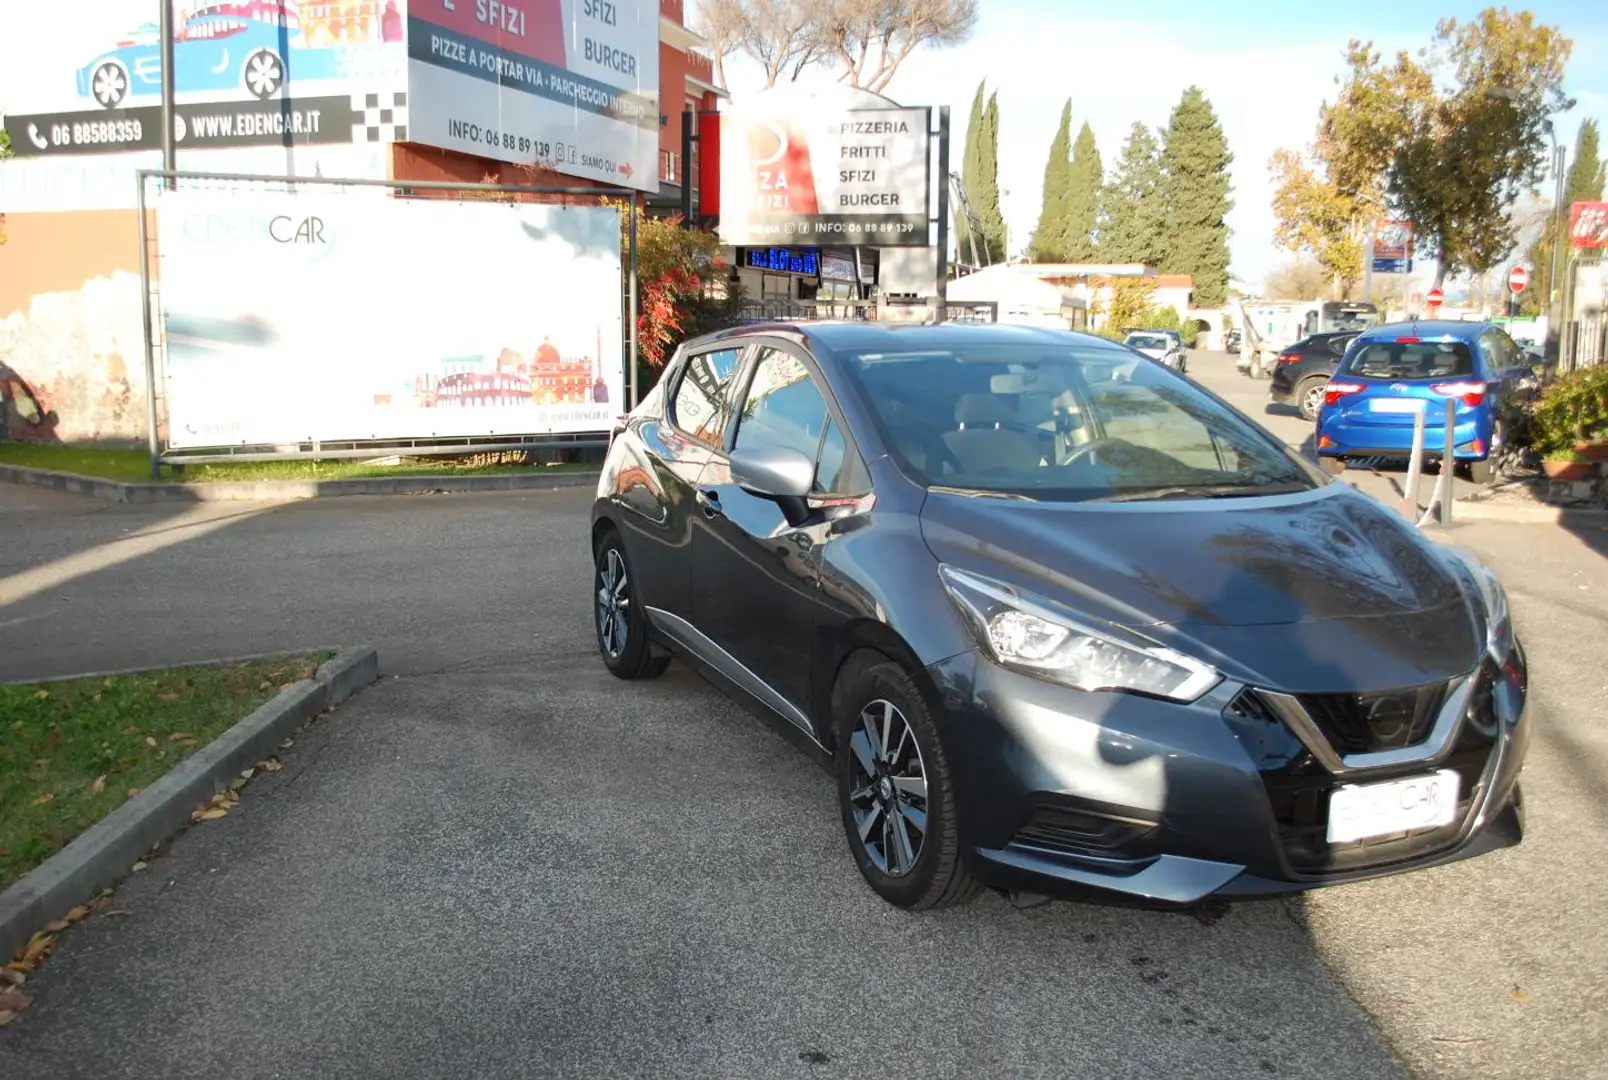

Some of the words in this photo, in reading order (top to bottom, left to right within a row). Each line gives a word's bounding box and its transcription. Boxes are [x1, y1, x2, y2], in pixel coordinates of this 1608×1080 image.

[476, 0, 525, 37] SFIZI
[584, 0, 616, 27] SFIZI
[584, 36, 637, 78] BURGER
[431, 34, 466, 64] PIZZE
[469, 47, 477, 67] A
[479, 51, 524, 82] PORTAR
[525, 66, 543, 87] VIA
[550, 74, 609, 108] PARCHEGGIO
[51, 122, 71, 146] 06
[73, 118, 143, 144] 88588359
[191, 109, 321, 138] WWW.EDENCAR.IT
[840, 121, 910, 135] PIZZERIA
[448, 118, 483, 142] INFO:
[485, 128, 500, 146] 06
[502, 133, 516, 150] 88
[518, 136, 531, 153] 89
[533, 140, 550, 158] 139
[581, 154, 604, 170] SIAMO
[604, 159, 617, 175] QUI
[840, 145, 887, 159] FRITTI
[839, 169, 876, 183] SFIZI
[839, 192, 900, 206] BURGER
[814, 222, 846, 234] INFO:
[848, 223, 862, 233] 06
[864, 223, 878, 233] 88
[895, 223, 915, 233] 139
